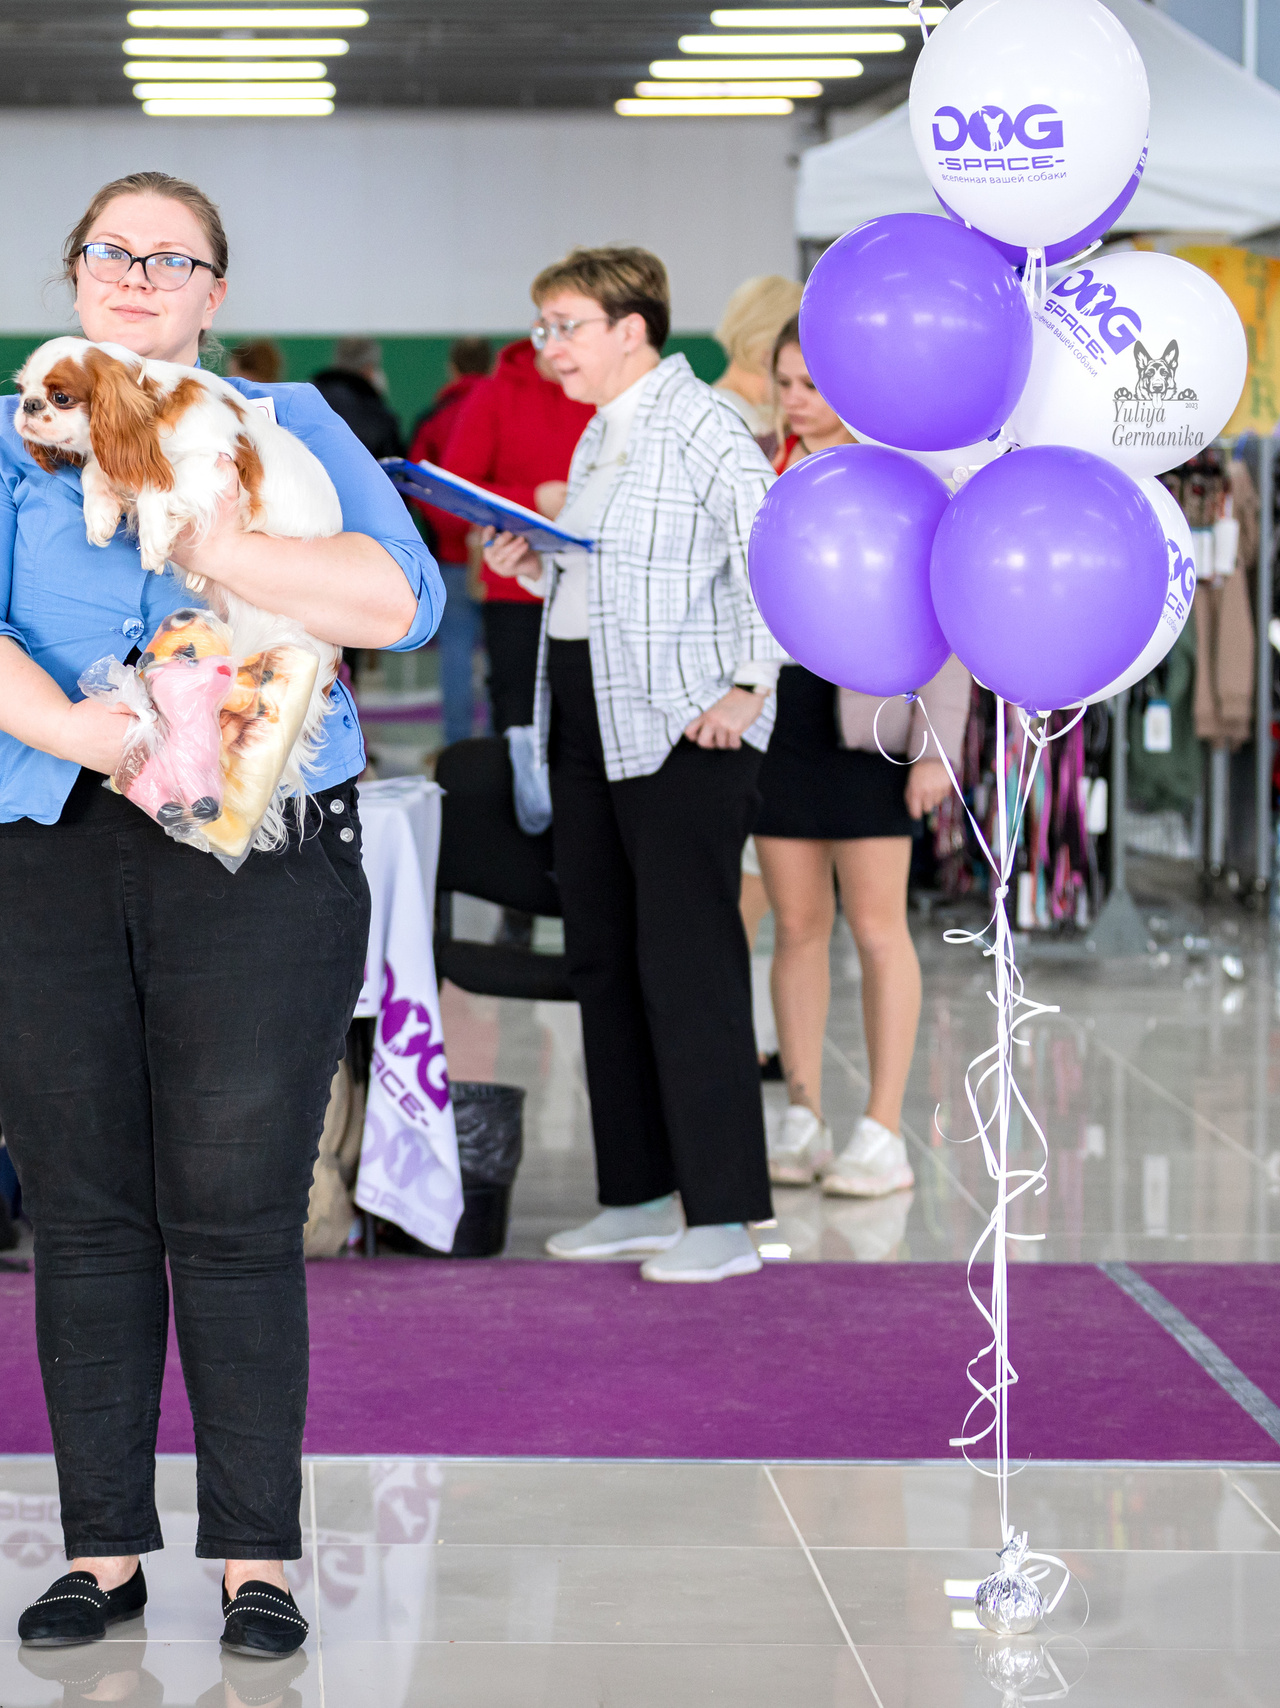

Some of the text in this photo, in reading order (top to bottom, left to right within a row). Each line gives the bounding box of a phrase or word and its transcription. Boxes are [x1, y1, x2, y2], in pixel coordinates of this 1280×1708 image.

[932, 104, 1064, 152] DOG
[941, 171, 1067, 184] вселенная вашей собаки
[1051, 269, 1142, 356] DOG
